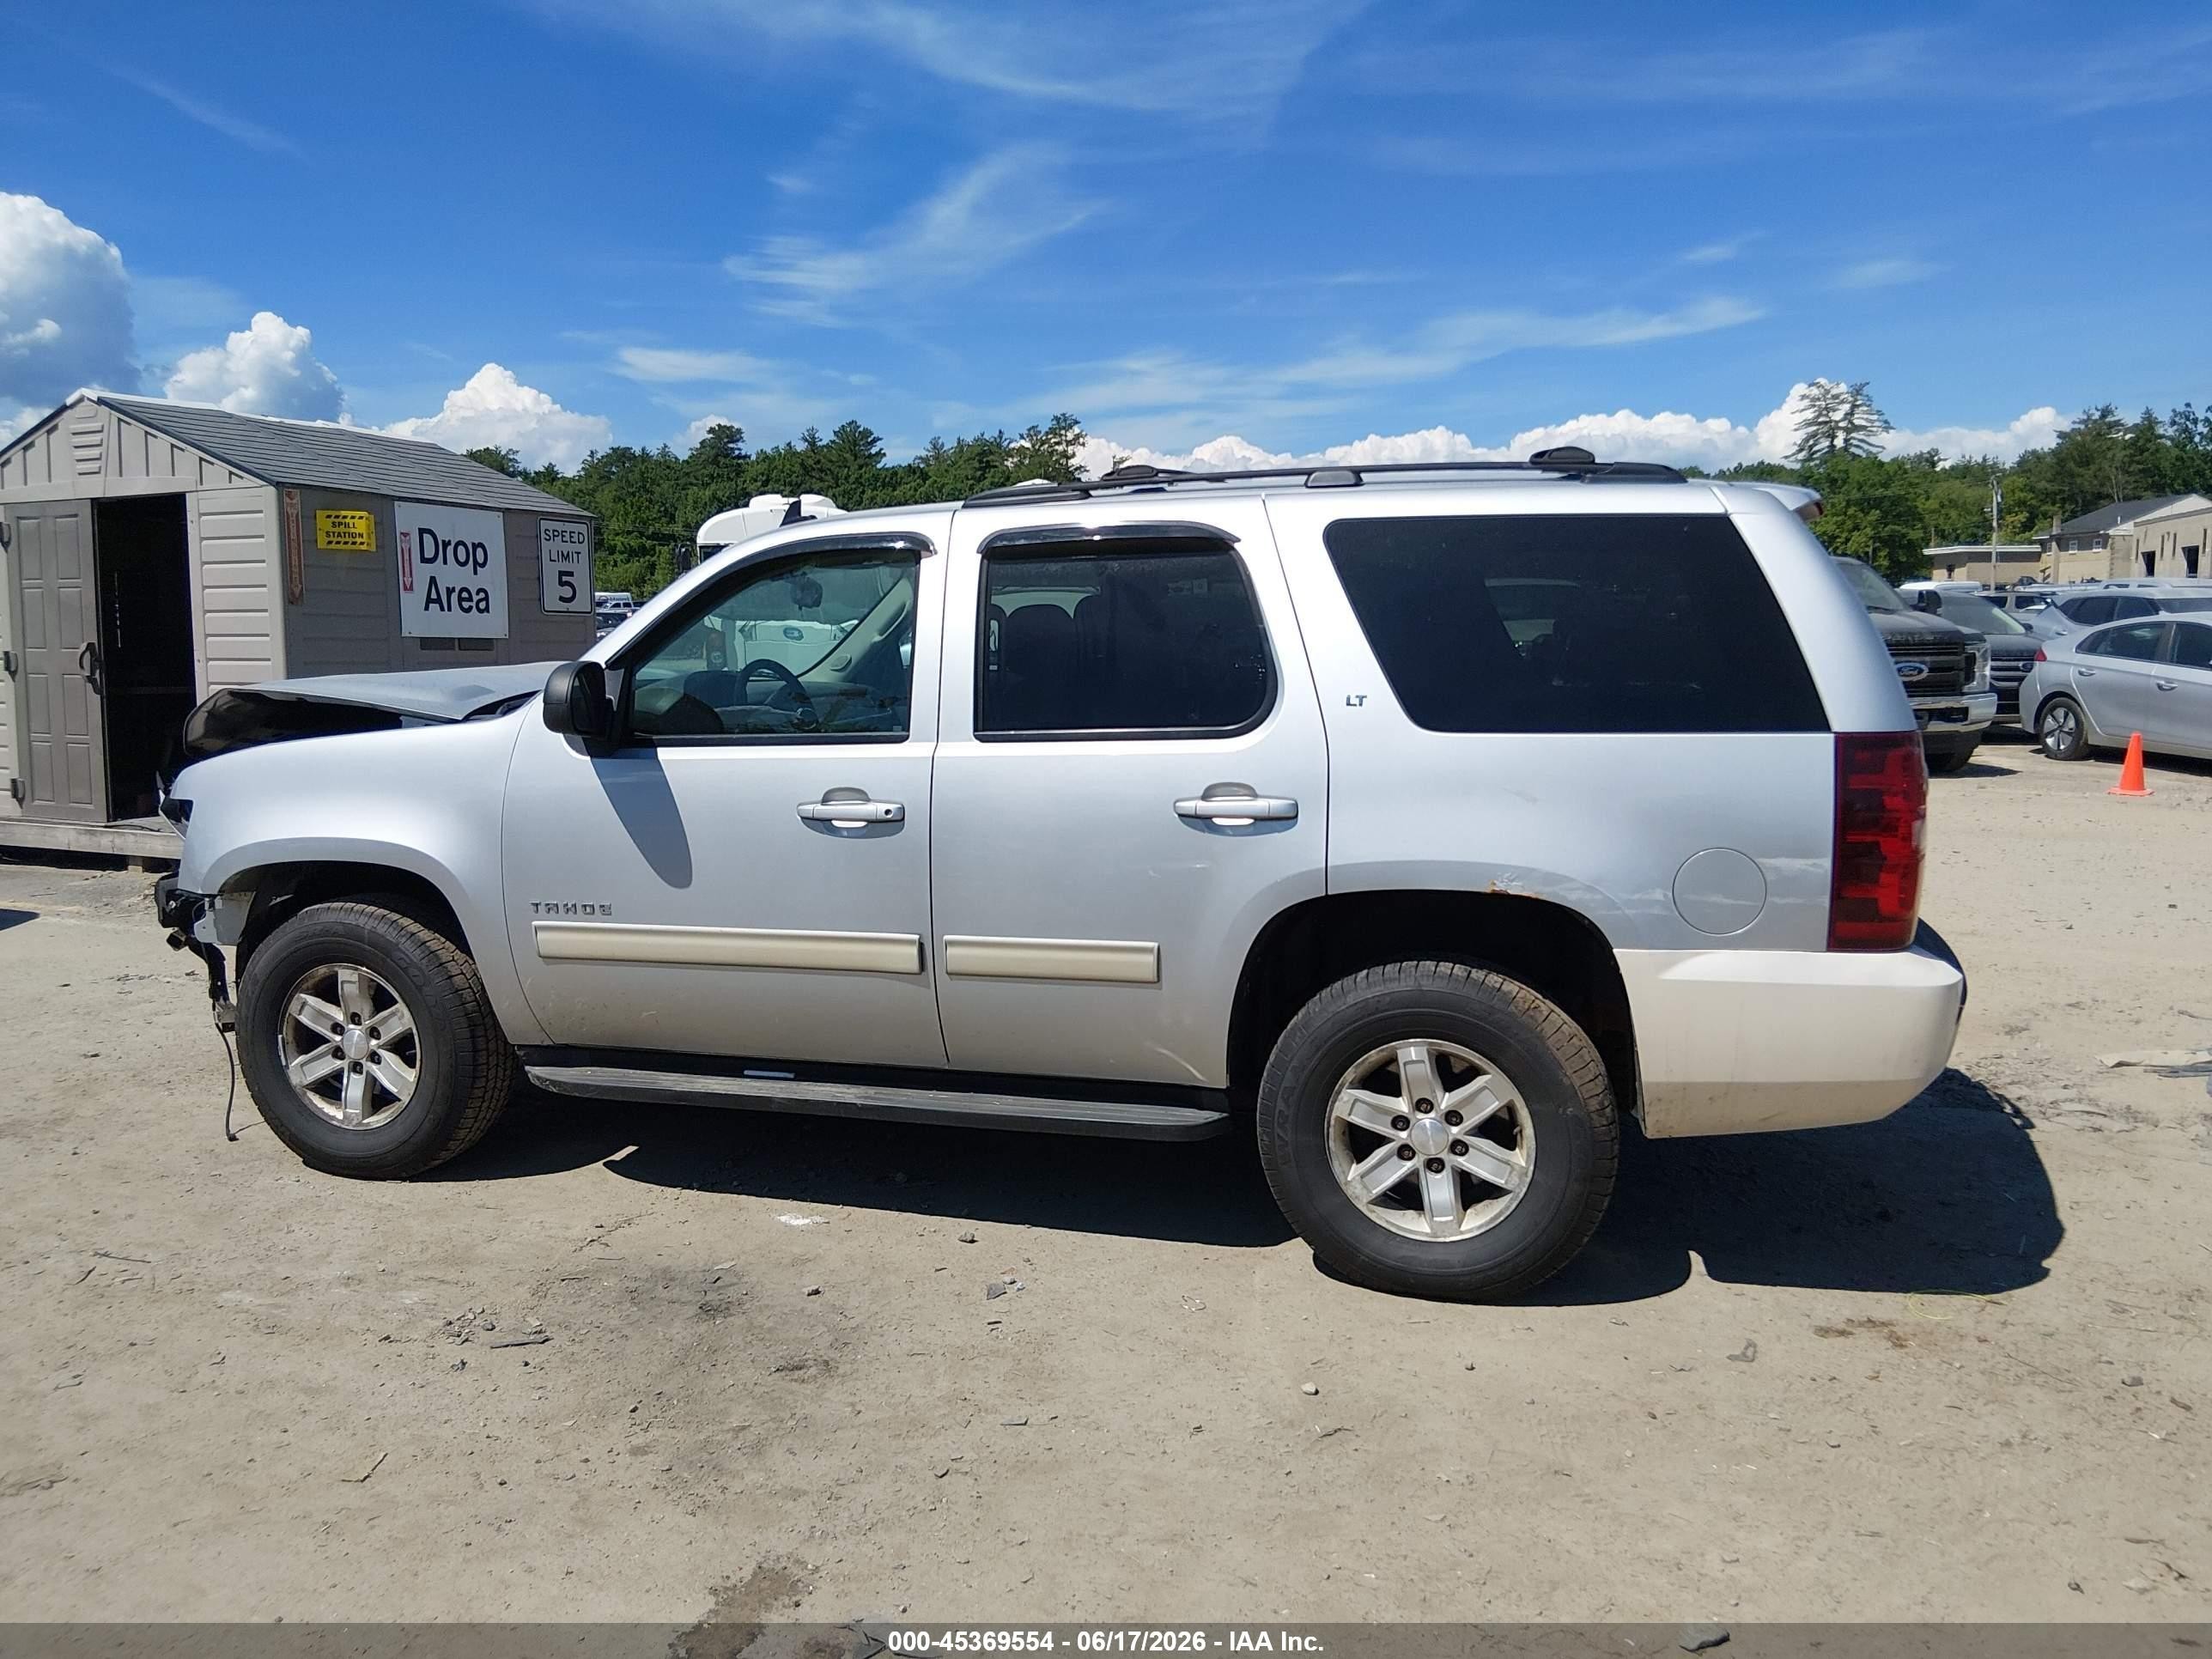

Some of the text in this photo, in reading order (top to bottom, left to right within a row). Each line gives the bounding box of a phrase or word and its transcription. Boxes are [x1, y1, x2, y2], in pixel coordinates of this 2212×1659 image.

[325, 531, 364, 539] STATION
[544, 528, 586, 544] SPEED
[418, 527, 489, 575] Drop
[549, 549, 581, 564] LIMIT
[557, 569, 577, 604] 5
[424, 575, 490, 614] Area
[1346, 694, 1368, 707] LT
[529, 902, 612, 916] TAHOE
